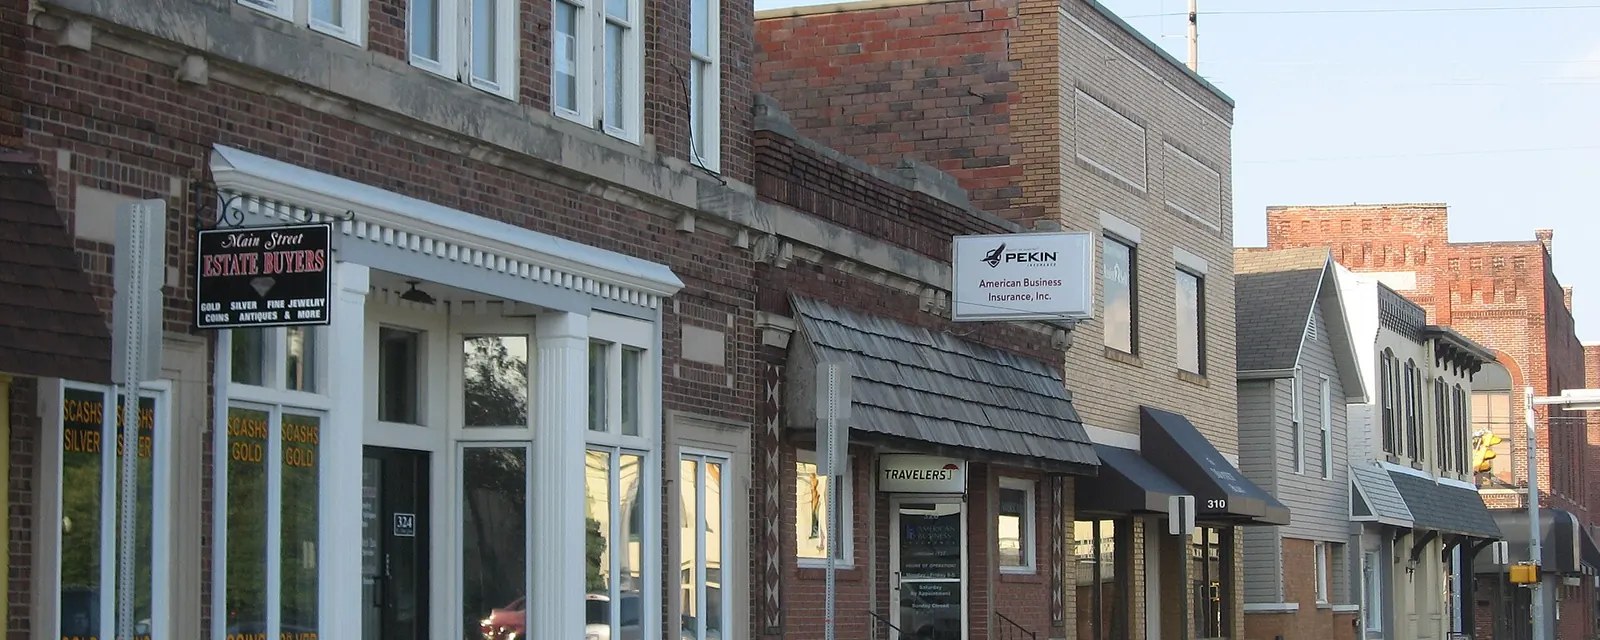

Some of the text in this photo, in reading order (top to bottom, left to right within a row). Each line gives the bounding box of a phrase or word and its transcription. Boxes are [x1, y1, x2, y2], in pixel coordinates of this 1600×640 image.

[220, 231, 304, 250] Main Street
[202, 249, 325, 277] ESTATE BUYERS
[1005, 251, 1057, 263] PEKIN
[979, 277, 1062, 288] American Business
[988, 291, 1051, 302] Insurance, Inc.
[200, 298, 325, 312] GOLD SILVER FINE JEWELRY
[205, 309, 321, 323] COINS ANTIQUES & MORE
[64, 428, 100, 454] SILVER
[117, 433, 151, 458] SER
[231, 441, 262, 463] GOLD
[285, 447, 314, 468] GOLD
[885, 469, 947, 481] TRAVELERS
[1207, 499, 1226, 509] 310
[396, 516, 412, 528] 324
